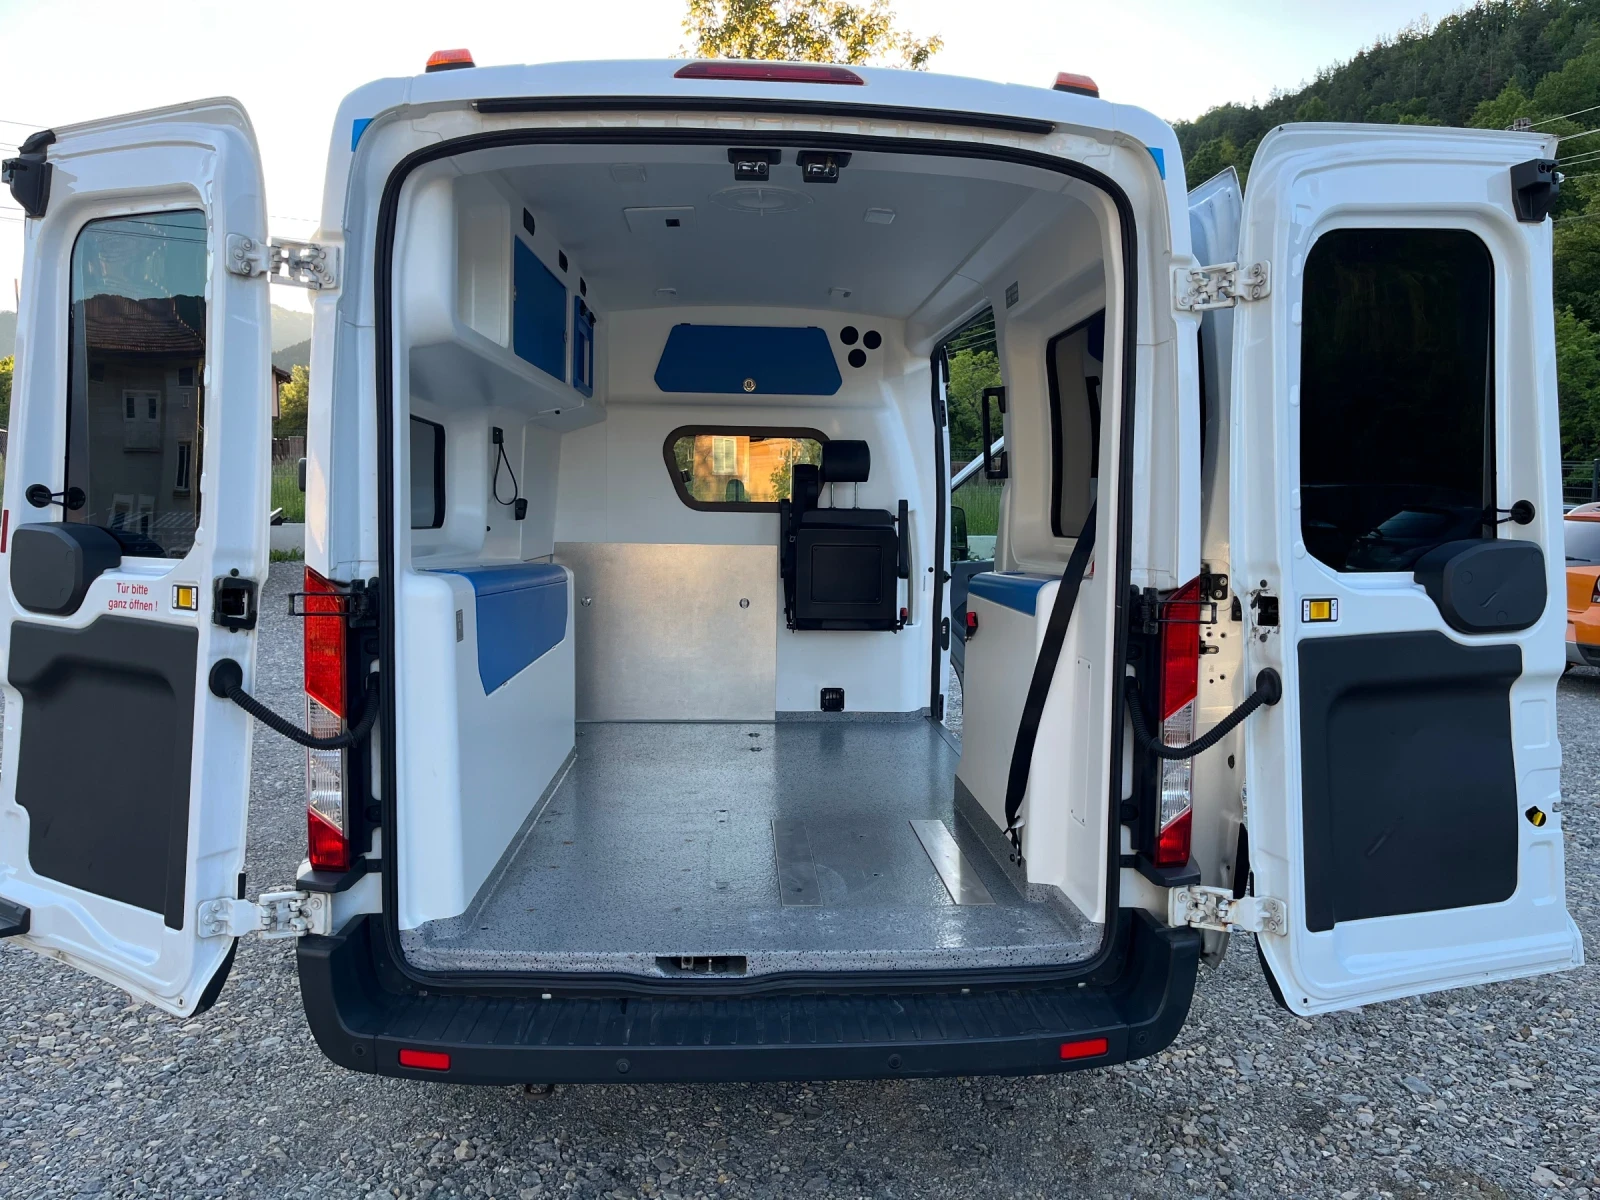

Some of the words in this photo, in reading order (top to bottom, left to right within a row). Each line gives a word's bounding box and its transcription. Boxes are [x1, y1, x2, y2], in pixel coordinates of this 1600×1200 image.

[116, 582, 129, 594] Tür
[131, 583, 149, 596] bitte
[108, 599, 127, 610] ganz
[129, 598, 153, 612] öffnen
